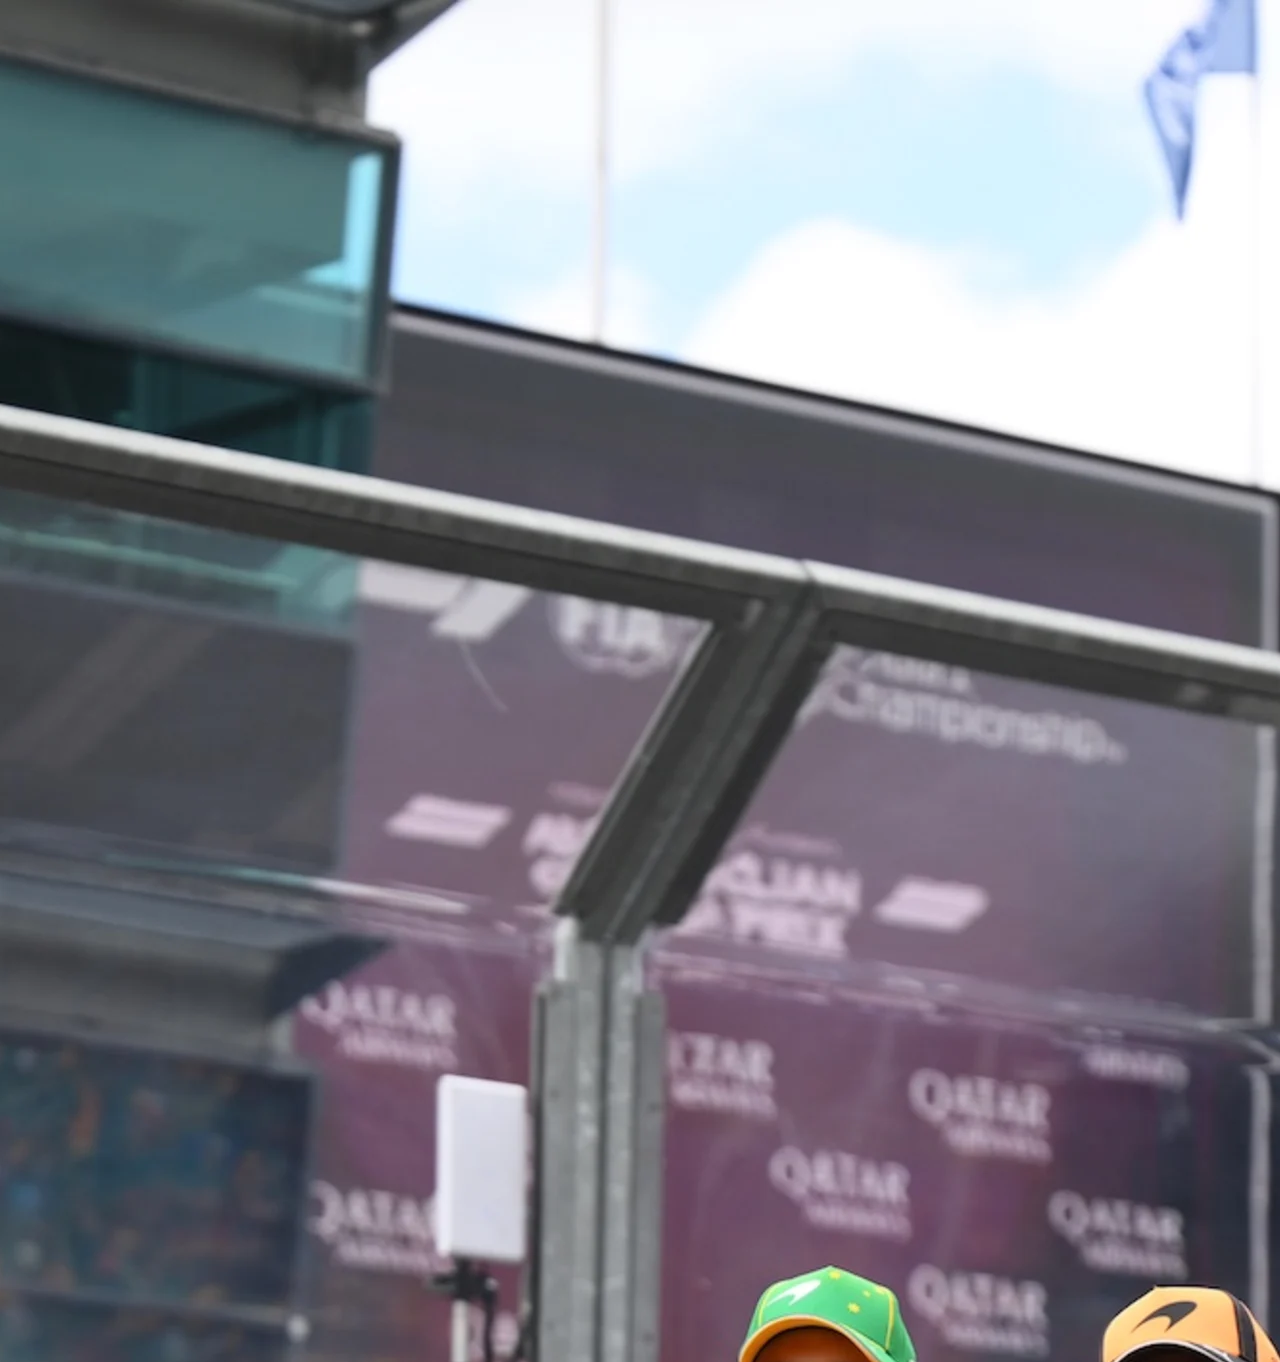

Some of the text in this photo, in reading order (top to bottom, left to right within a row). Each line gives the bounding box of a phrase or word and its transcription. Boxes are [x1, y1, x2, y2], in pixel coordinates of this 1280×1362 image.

[664, 1030, 776, 1086] ATAR
[908, 1068, 1052, 1134] QATAR
[768, 1145, 912, 1208] QATAR
[1047, 1189, 1184, 1250] QATAR
[906, 1262, 1048, 1326] QATAR
